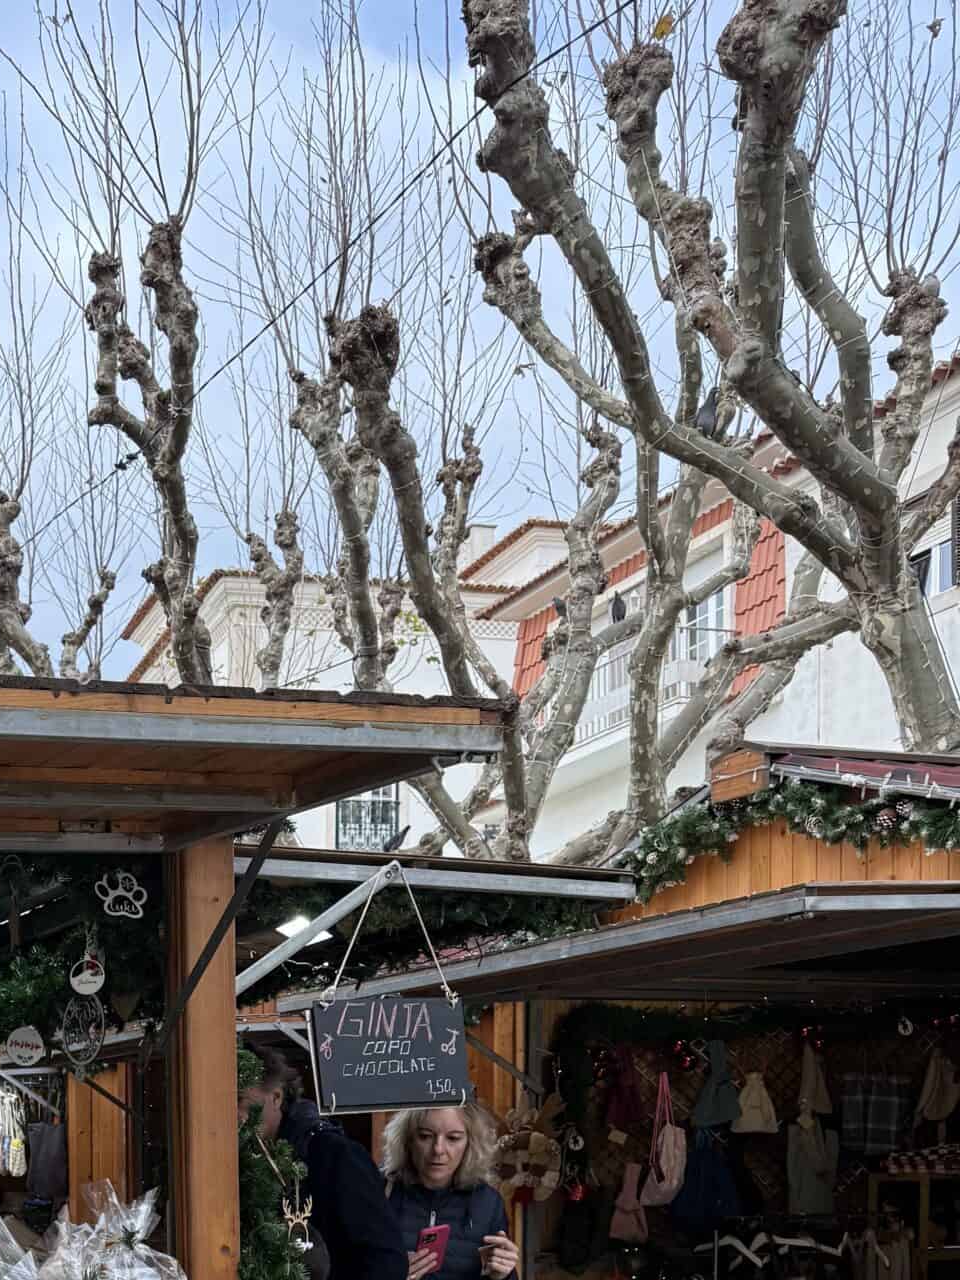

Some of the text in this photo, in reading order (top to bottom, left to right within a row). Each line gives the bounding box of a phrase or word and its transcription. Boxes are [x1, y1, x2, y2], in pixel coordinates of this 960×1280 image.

[337, 1001, 433, 1042] GINJA
[362, 1040, 411, 1056] COPO
[342, 1057, 437, 1077] CHOCOLATE
